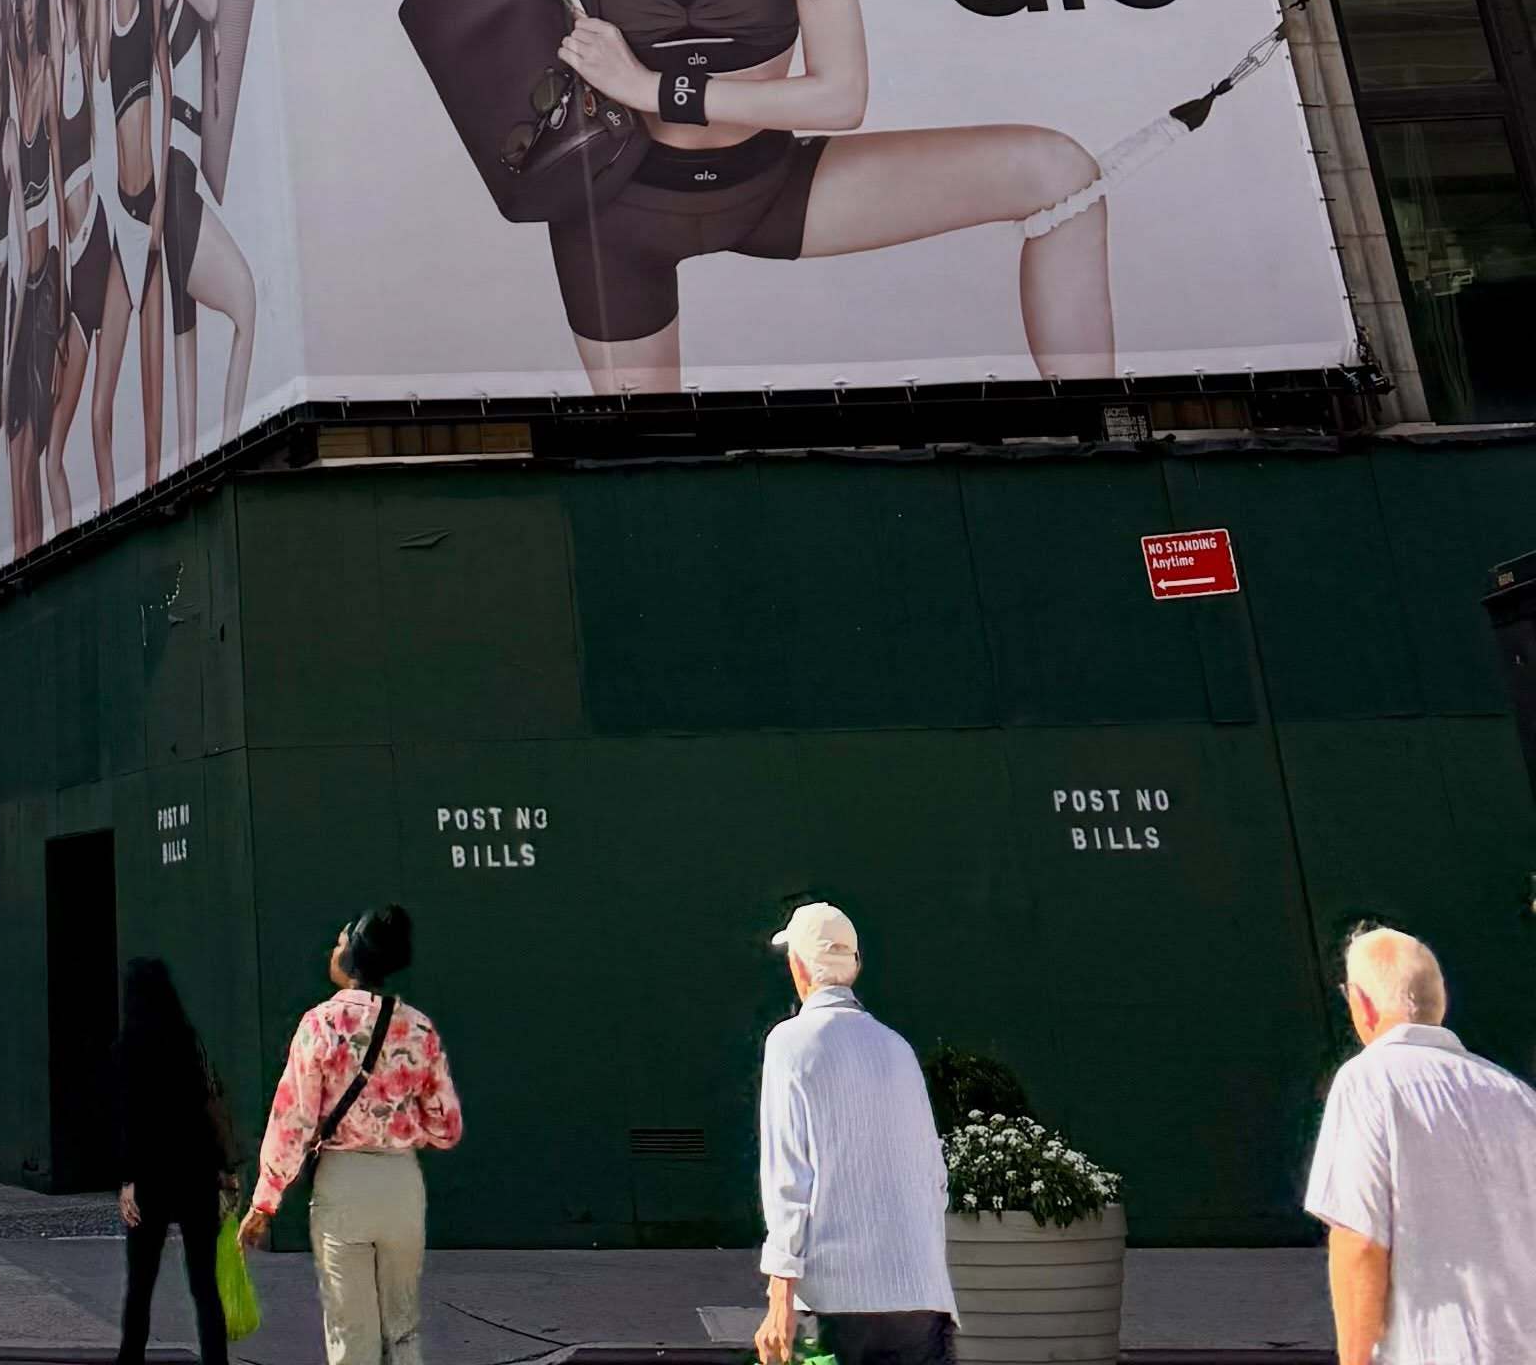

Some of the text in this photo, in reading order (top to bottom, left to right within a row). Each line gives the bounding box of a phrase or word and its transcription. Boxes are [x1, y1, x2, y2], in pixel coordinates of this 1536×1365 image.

[687, 52, 708, 65] alo
[673, 75, 696, 105] alo
[693, 170, 718, 181] alo
[1147, 537, 1217, 555] NO STANDING
[1152, 555, 1195, 570] Anytime
[1053, 789, 1169, 812] POST NO
[438, 806, 548, 830] POST NO
[1071, 826, 1160, 850] BILLS
[162, 838, 187, 864] BILLS
[451, 843, 536, 868] BILLS
